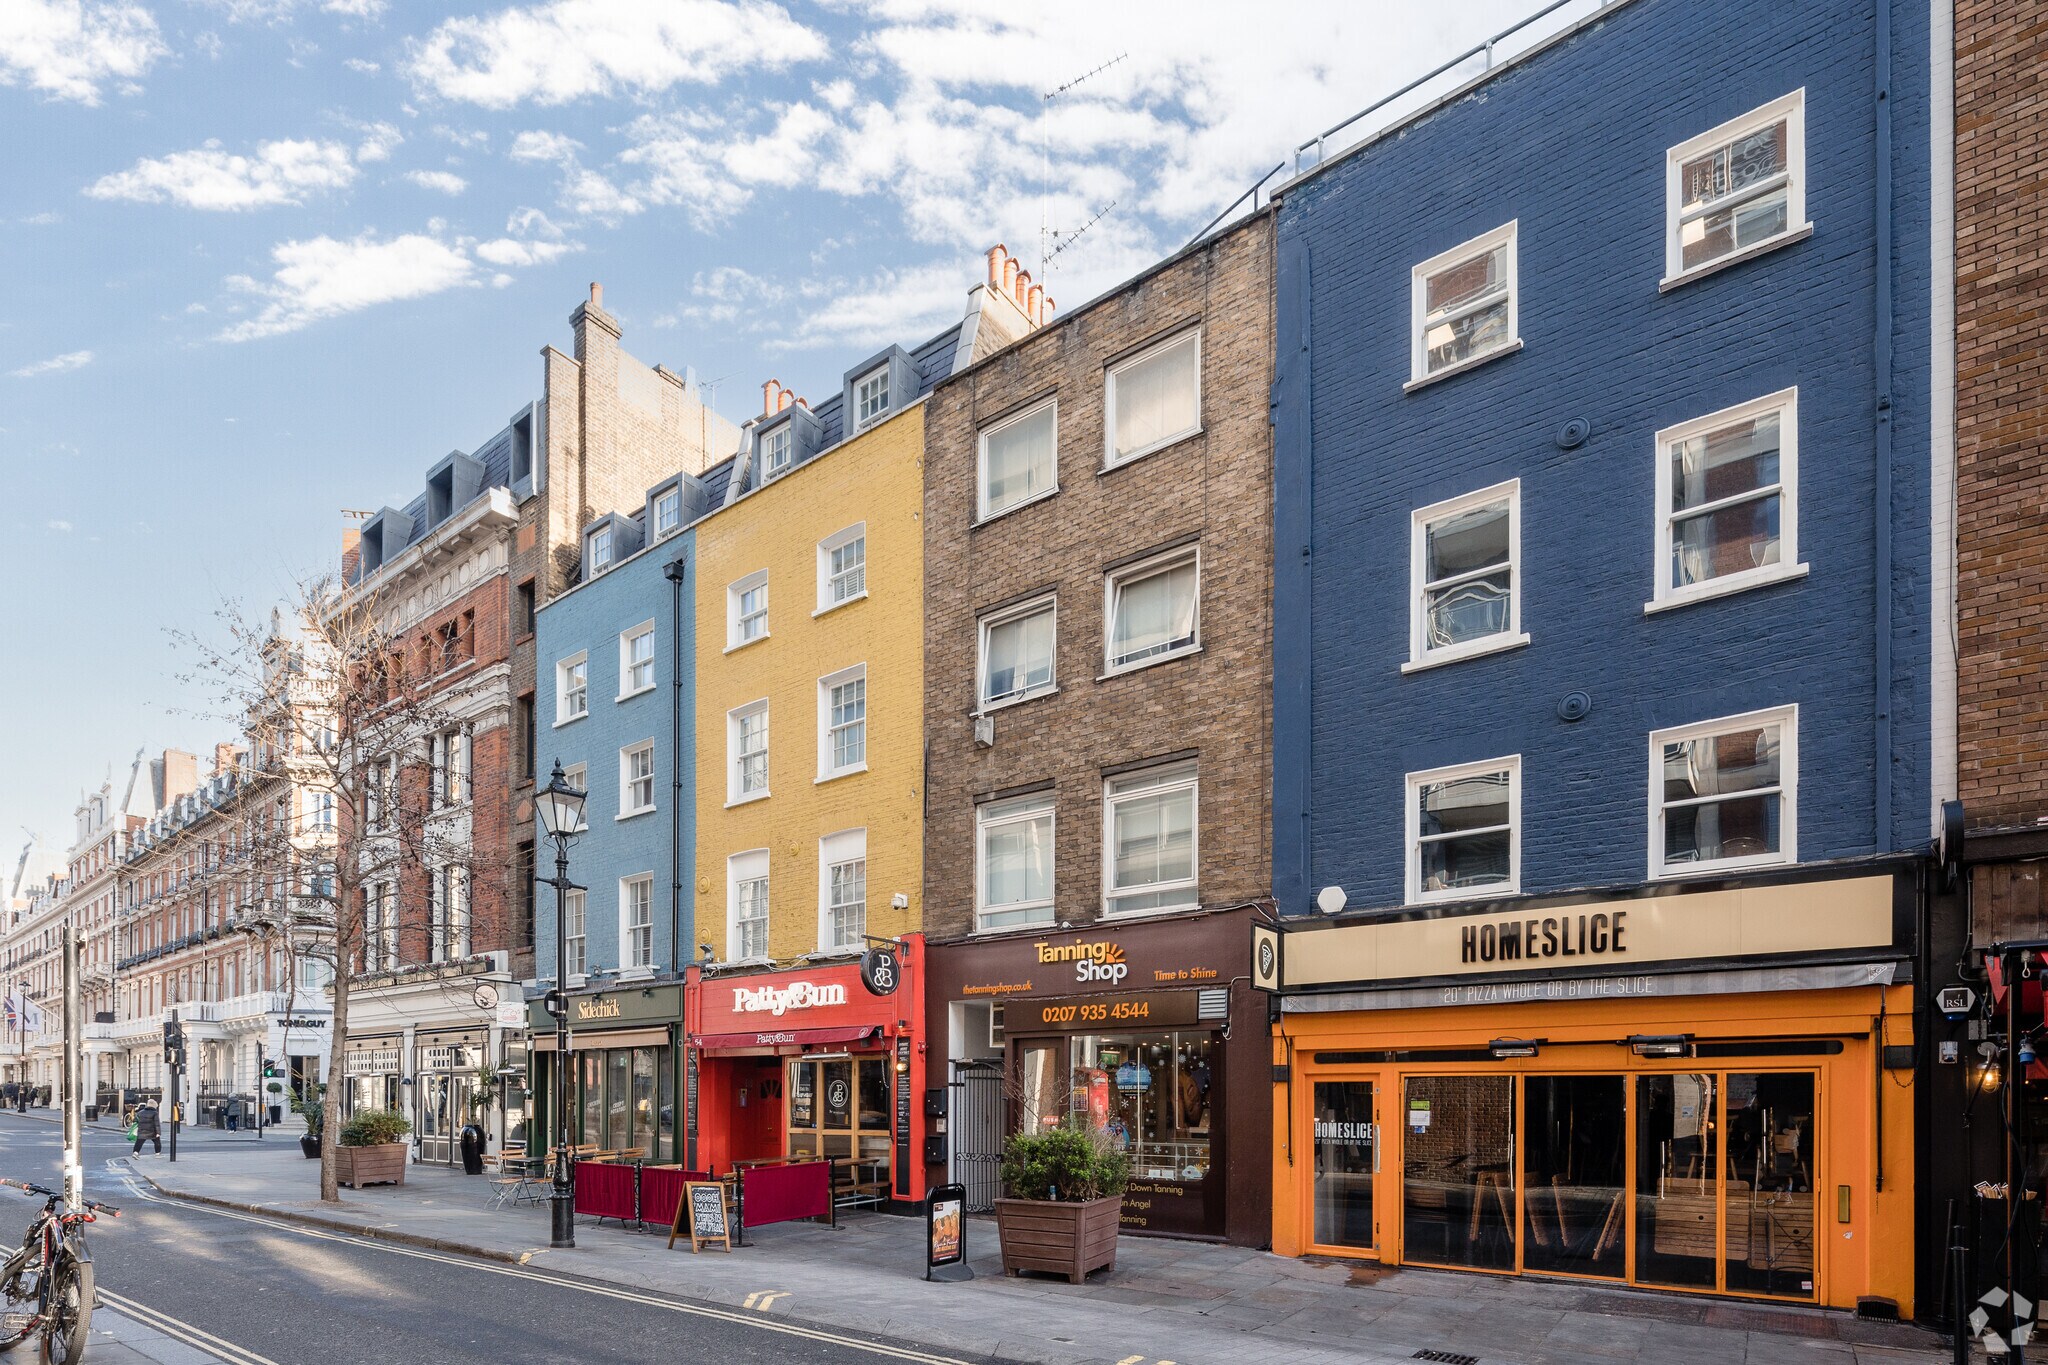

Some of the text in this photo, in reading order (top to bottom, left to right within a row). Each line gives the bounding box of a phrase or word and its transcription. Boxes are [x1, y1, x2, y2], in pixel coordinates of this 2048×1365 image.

[1461, 911, 1627, 963] HOMESLICE
[1034, 939, 1107, 964] Tanning
[1076, 959, 1128, 985] Shop
[1154, 967, 1217, 980] Time to Shine
[963, 980, 1032, 995] thetanningshop.co.uk
[1467, 985, 1497, 1001] PIZZA
[1503, 982, 1541, 999] WHOLE
[1547, 981, 1563, 997] OR
[1568, 980, 1583, 996] BY
[1589, 978, 1610, 995] THE
[1617, 976, 1652, 994] SLICE
[732, 981, 847, 1016] Patty&Bun
[1946, 999, 1967, 1008] RSL
[578, 999, 621, 1019] Sidechick
[1042, 1002, 1149, 1023] 0207 935 4544
[756, 1033, 795, 1045] Patty&Bun
[1314, 1122, 1373, 1139] HOMESLICE
[1130, 1182, 1153, 1193] Down
[1153, 1183, 1184, 1196] Tanning
[1130, 1198, 1151, 1210] Angel
[1119, 1213, 1147, 1226] Tanning
